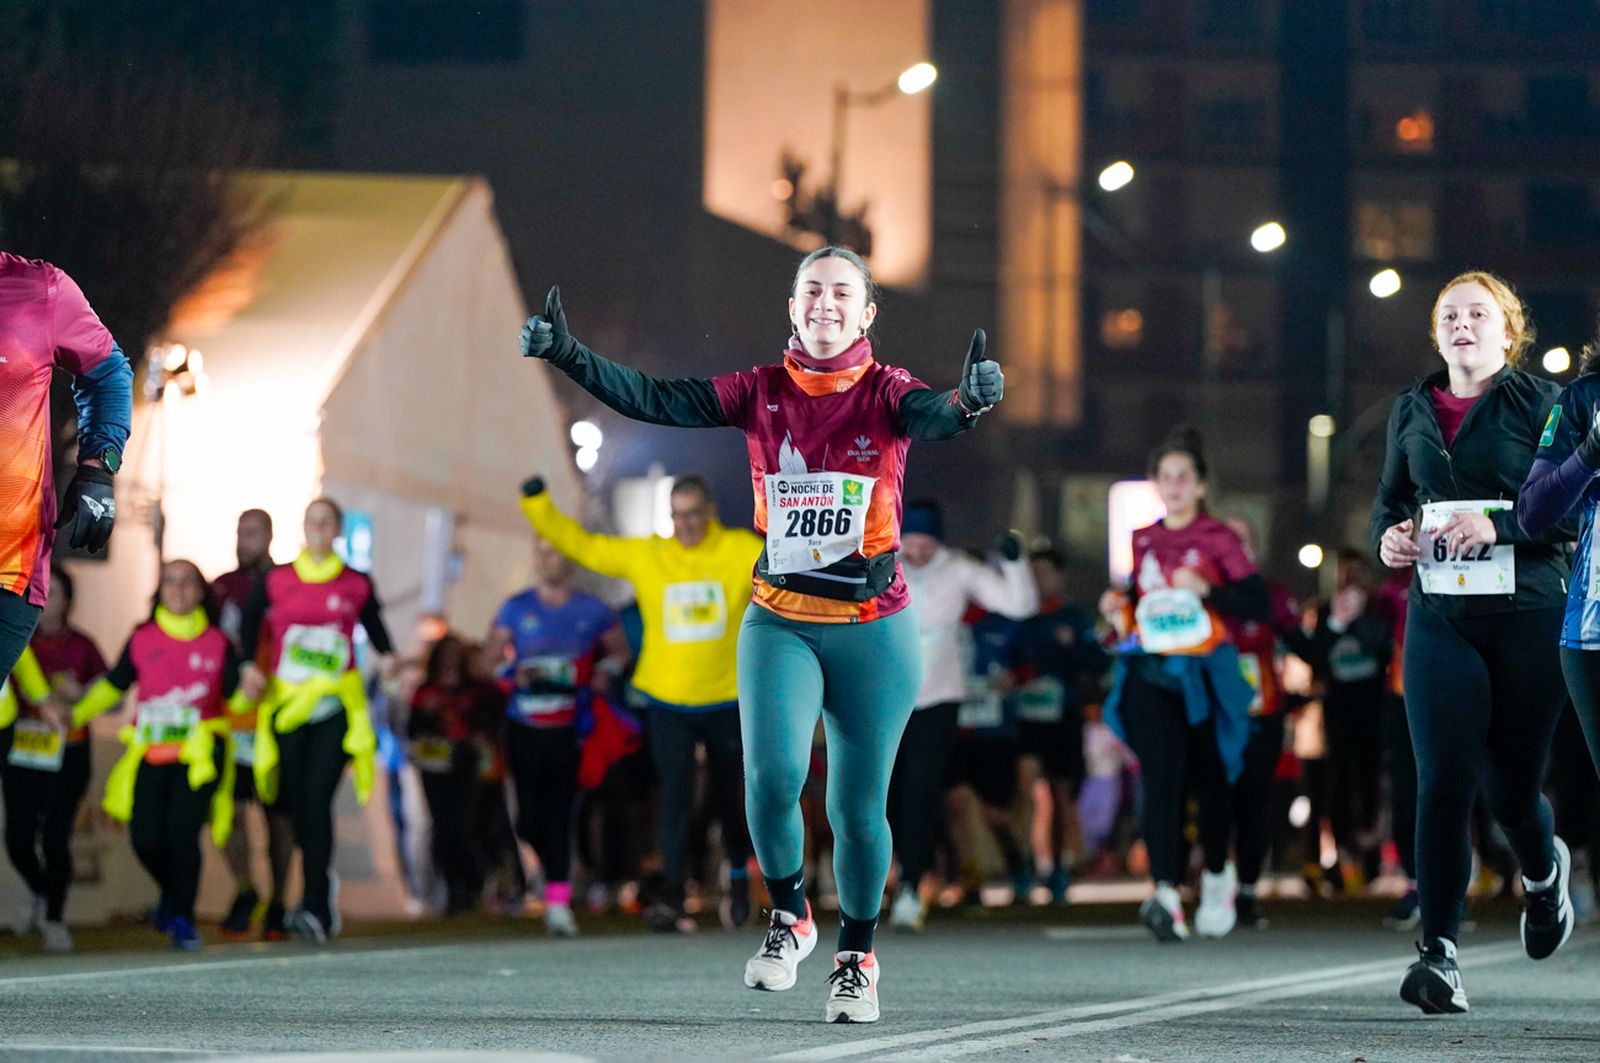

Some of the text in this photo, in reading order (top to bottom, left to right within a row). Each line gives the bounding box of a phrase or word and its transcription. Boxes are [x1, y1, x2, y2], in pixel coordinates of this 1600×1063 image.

[791, 484, 821, 494] NOCHE
[822, 484, 835, 494] DE
[779, 497, 800, 507] SAN
[785, 508, 852, 538] 2866
